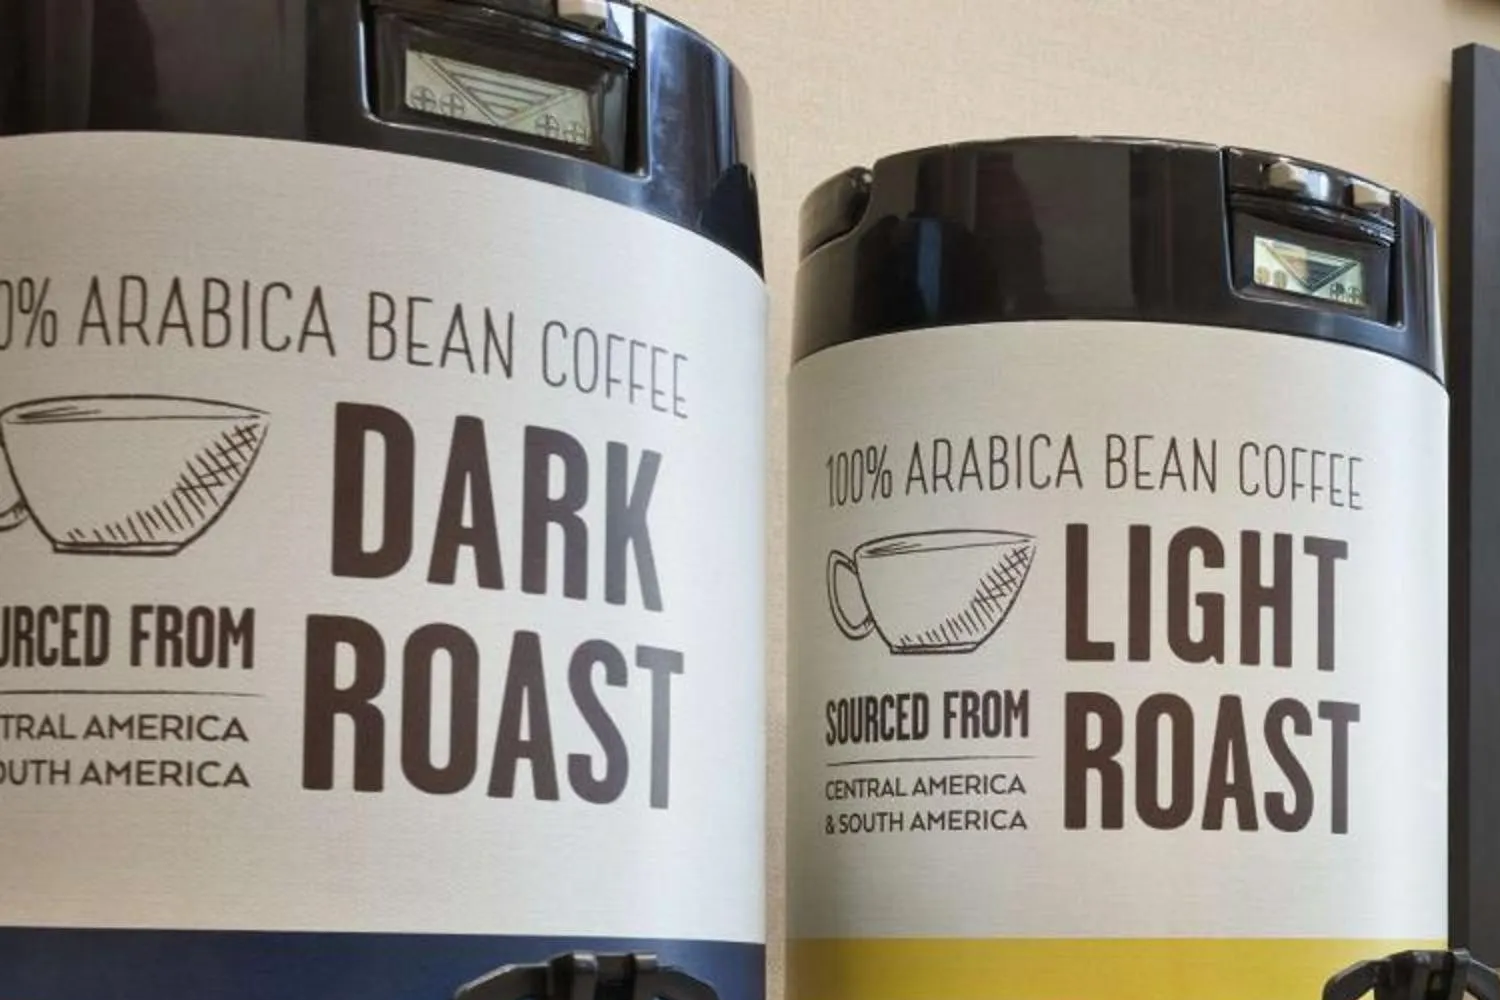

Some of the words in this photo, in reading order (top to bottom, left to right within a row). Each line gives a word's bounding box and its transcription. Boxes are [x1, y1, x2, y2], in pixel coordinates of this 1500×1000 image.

[78, 275, 336, 357] ARABICA
[367, 291, 514, 378] BEAN
[541, 320, 689, 419] COFFEE
[331, 402, 663, 612] DARK
[826, 443, 893, 507] 100%
[905, 433, 1083, 496] ARABICA
[1106, 435, 1216, 493] BEAN
[1239, 442, 1364, 510] COFFEE
[1065, 523, 1348, 671] LIGHT
[130, 604, 255, 670] FROM
[83, 713, 249, 742] AMERICA
[302, 614, 684, 809] ROAST
[826, 692, 929, 746] SOURCED
[943, 689, 1029, 739] FROM
[0, 759, 71, 787] UTH
[80, 759, 251, 788] AMERICA
[825, 777, 908, 800] CENTRAL
[912, 774, 1027, 796] AMERICA
[1064, 692, 1360, 835] ROAST
[825, 814, 835, 835] &
[839, 811, 903, 834] SOUTH
[910, 810, 1028, 831] AMERICA
